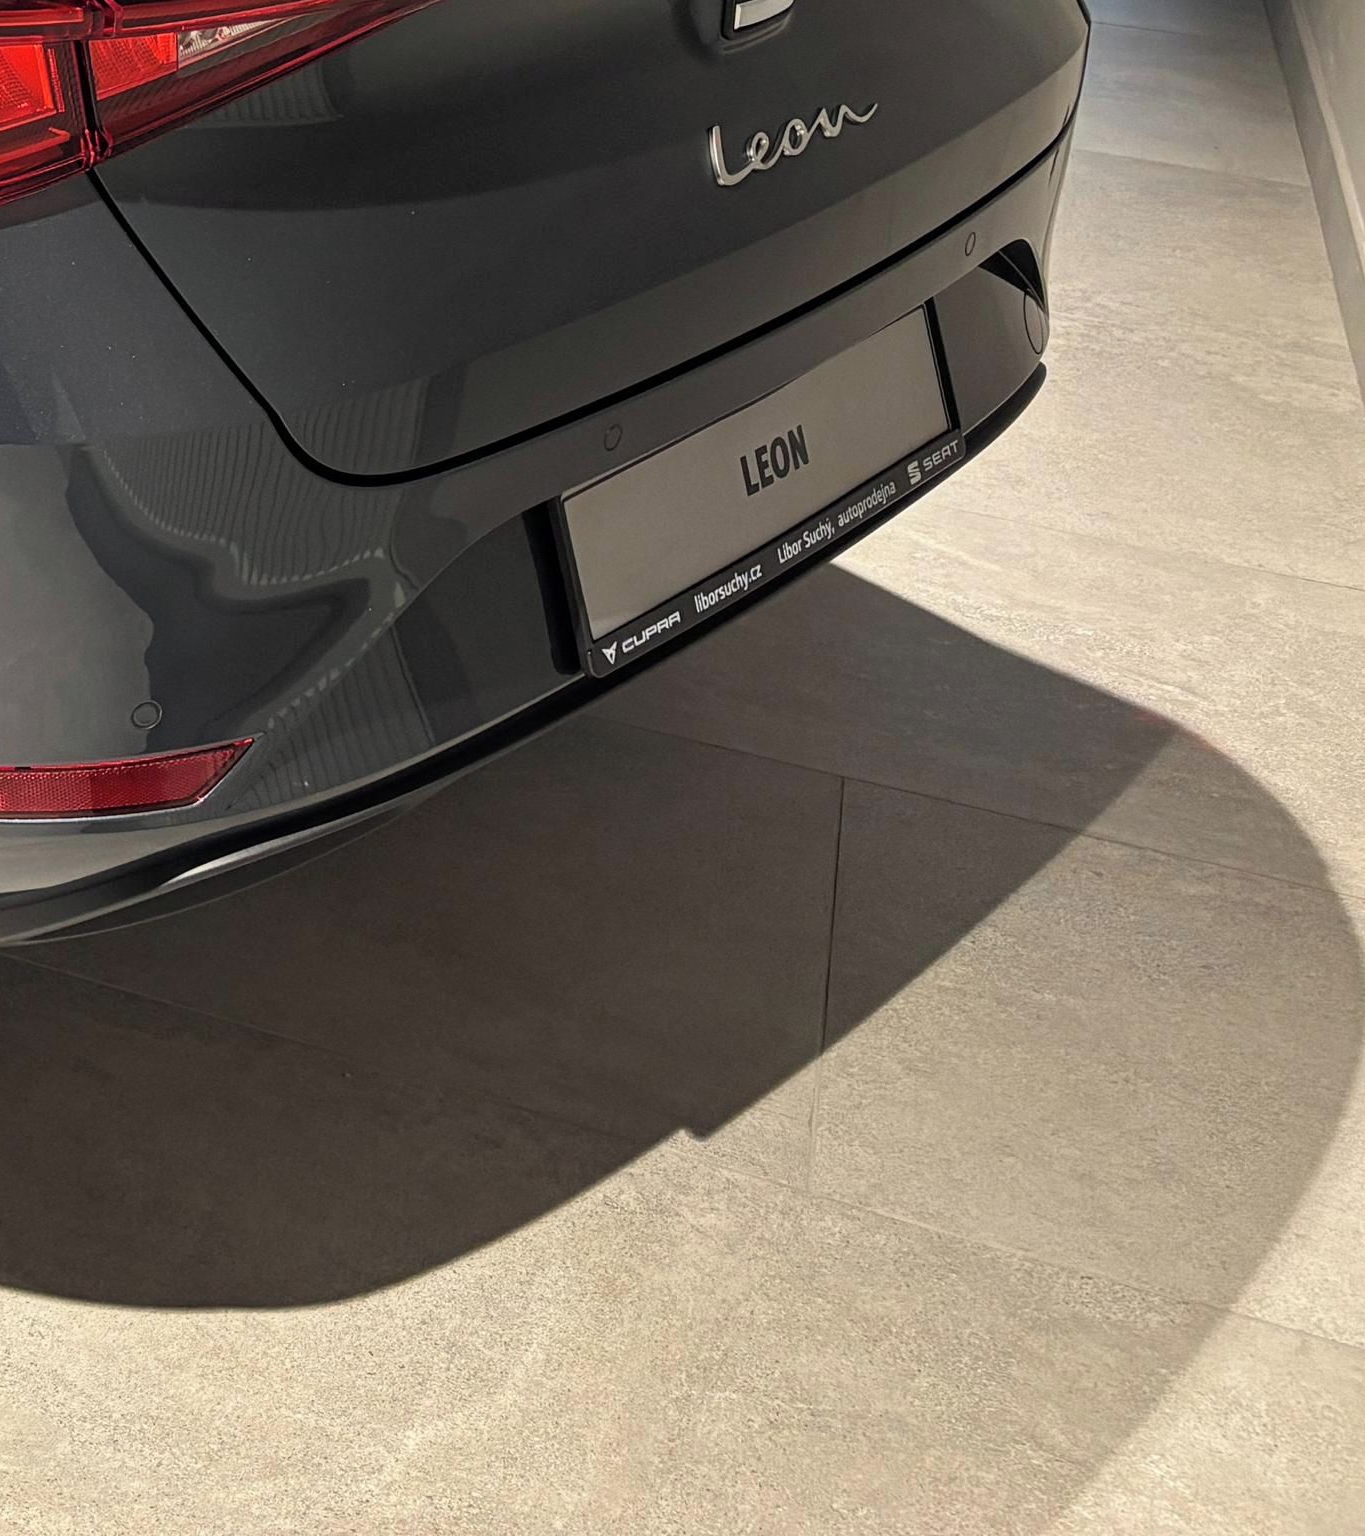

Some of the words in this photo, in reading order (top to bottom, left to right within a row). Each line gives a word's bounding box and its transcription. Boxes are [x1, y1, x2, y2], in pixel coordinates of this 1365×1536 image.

[739, 424, 810, 497] LEON
[621, 611, 681, 653] CUPRA
[694, 564, 763, 613] liborsuchy.cz
[777, 539, 803, 564] Libor
[837, 481, 897, 527] autoprodejna
[923, 439, 959, 472] SEAT
